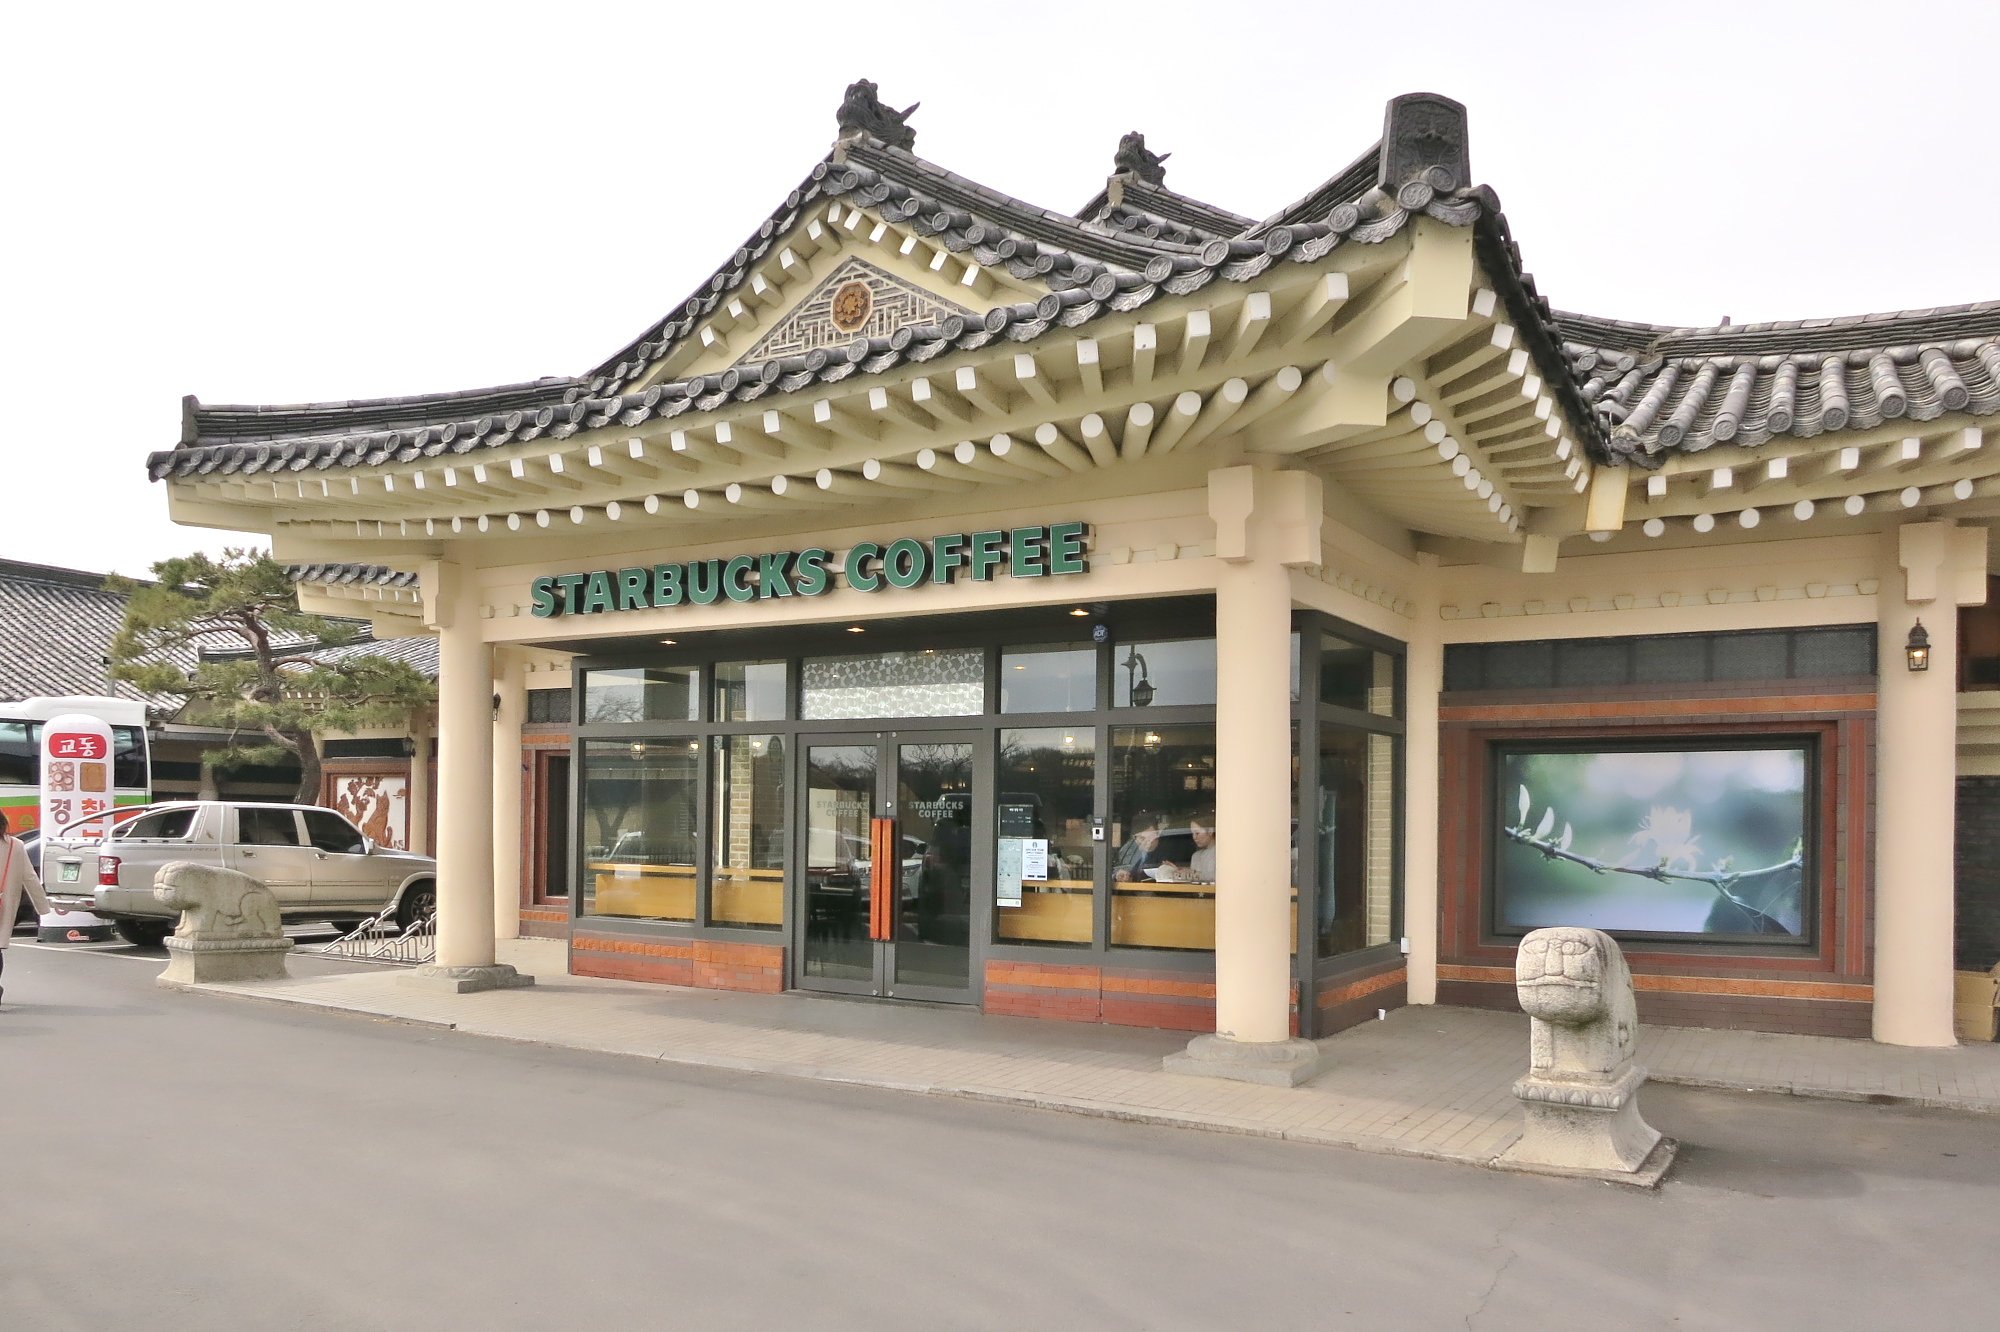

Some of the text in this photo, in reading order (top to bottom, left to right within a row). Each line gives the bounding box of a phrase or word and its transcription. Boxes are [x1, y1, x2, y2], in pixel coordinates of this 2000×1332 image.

[530, 521, 1088, 619] STARBUCKS COFFEE
[58, 736, 97, 757] 교동
[816, 801, 870, 810] STARBUCKS
[908, 801, 964, 810] STARBUCKS
[826, 809, 859, 817] COFFEE
[918, 810, 953, 818] COFFEE
